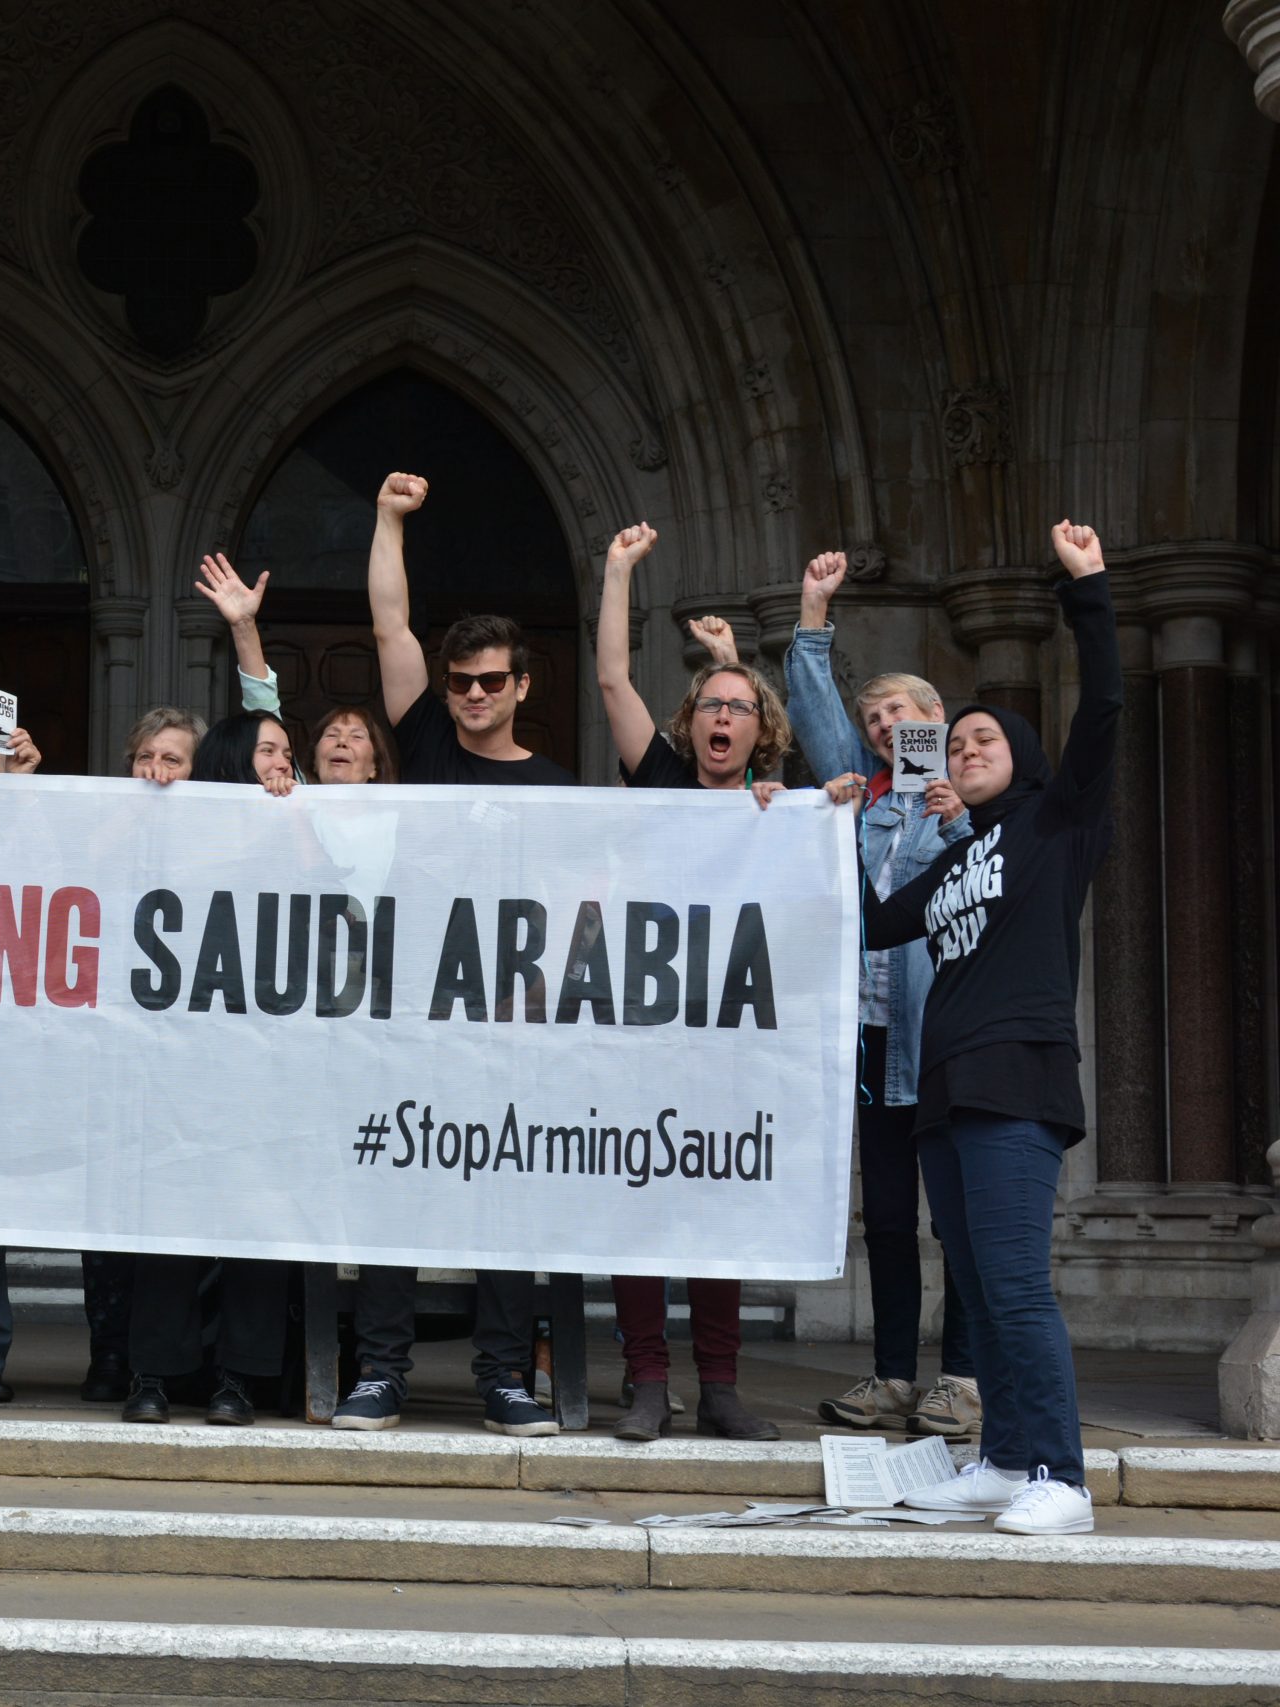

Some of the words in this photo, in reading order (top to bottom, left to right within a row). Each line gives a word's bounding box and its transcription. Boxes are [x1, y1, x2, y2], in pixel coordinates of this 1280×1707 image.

[900, 729, 936, 738] STOP
[901, 745, 937, 753] SAUDI
[130, 888, 396, 1019] SAUDI
[428, 897, 778, 1030] ARABIA
[353, 1100, 774, 1188] #StopArmingSaudi
